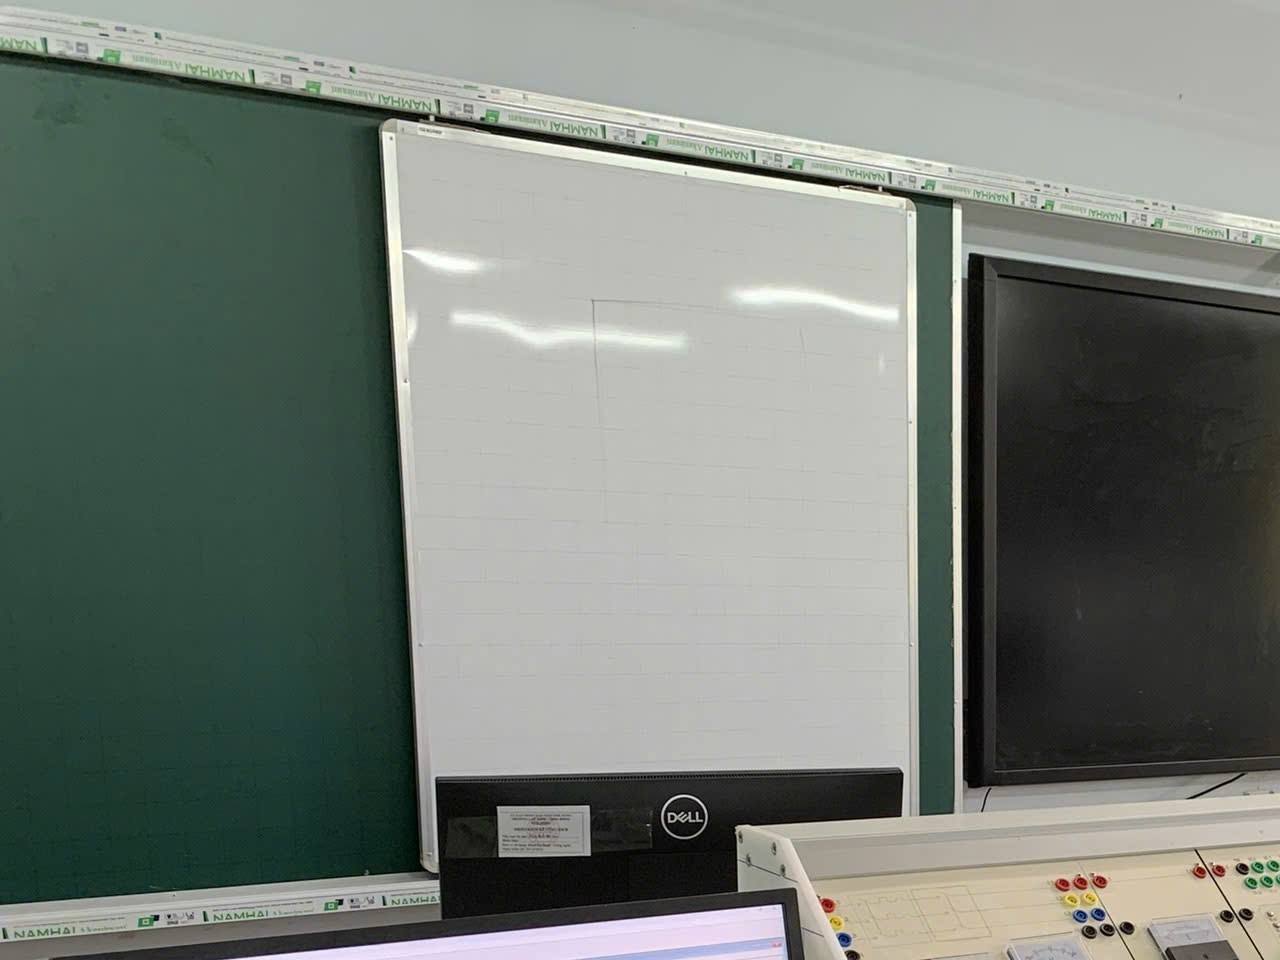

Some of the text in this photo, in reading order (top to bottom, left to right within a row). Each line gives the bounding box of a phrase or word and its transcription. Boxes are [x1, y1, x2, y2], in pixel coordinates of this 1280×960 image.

[667, 811, 703, 823] DELL
[213, 911, 269, 922] NAMHAI
[14, 927, 76, 939] NAMHAI
